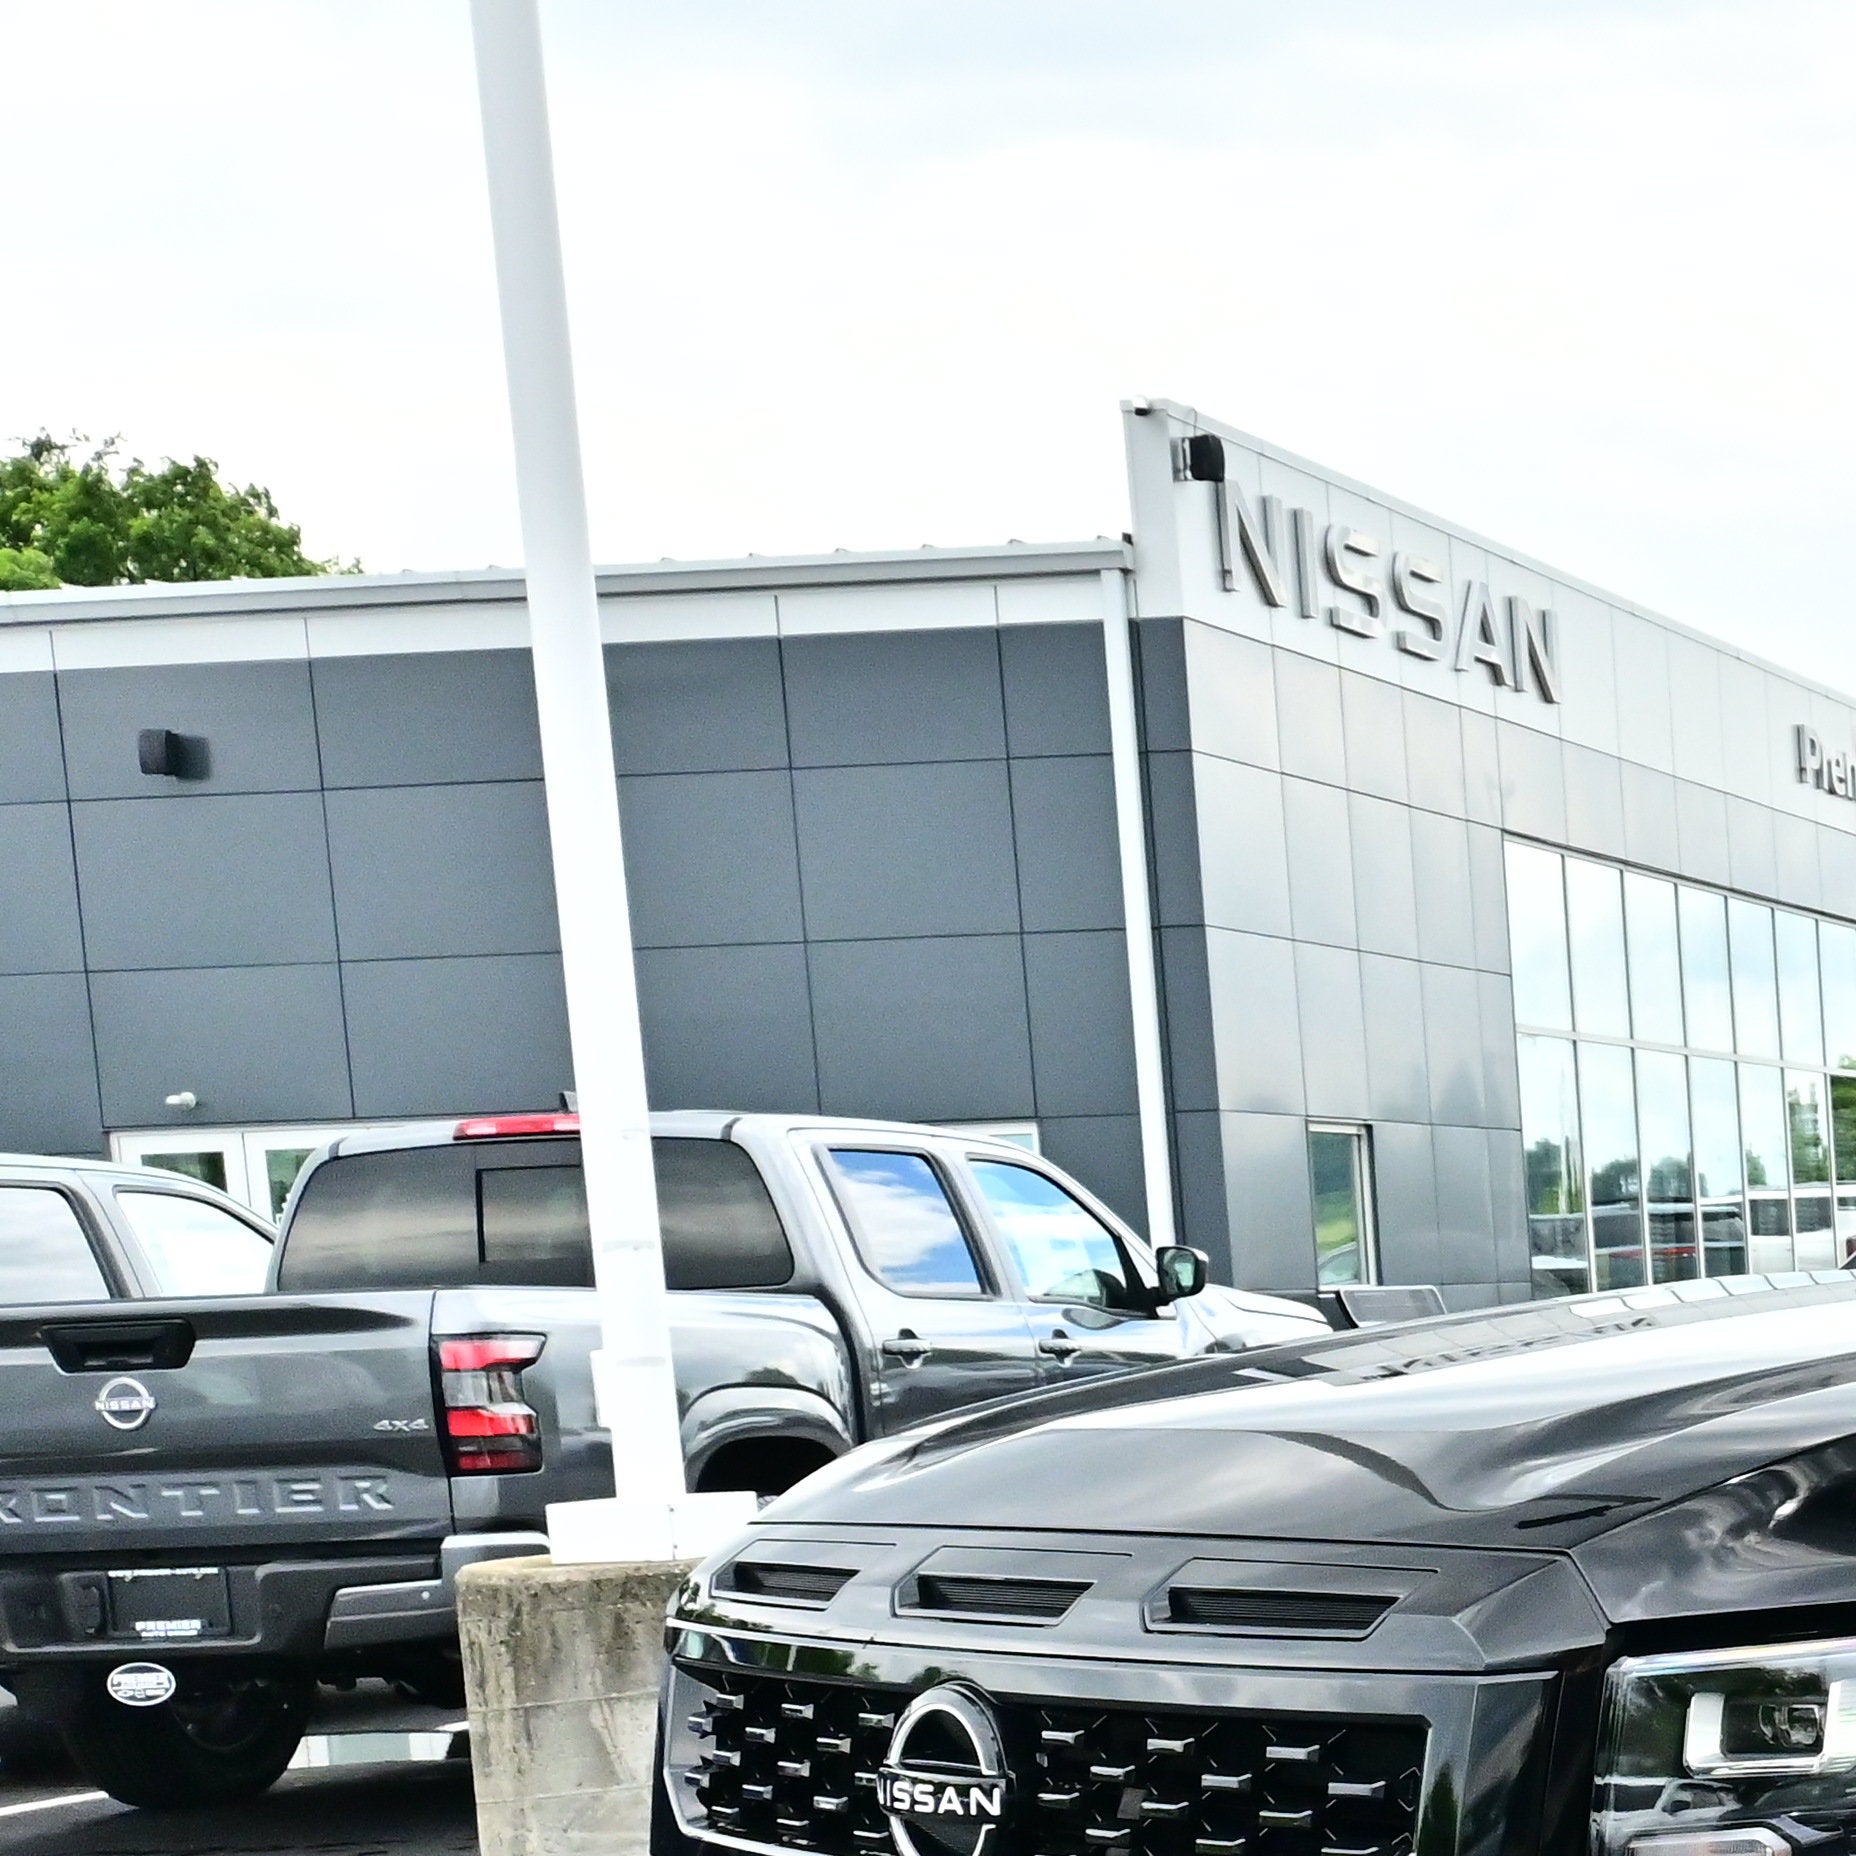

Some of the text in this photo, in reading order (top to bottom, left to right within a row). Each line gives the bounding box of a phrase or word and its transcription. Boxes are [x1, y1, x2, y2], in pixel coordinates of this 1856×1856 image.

[1215, 479, 1561, 704] NISSAN
[95, 1396, 155, 1411] NISSAN
[876, 1776, 1001, 1816] NISSAN
